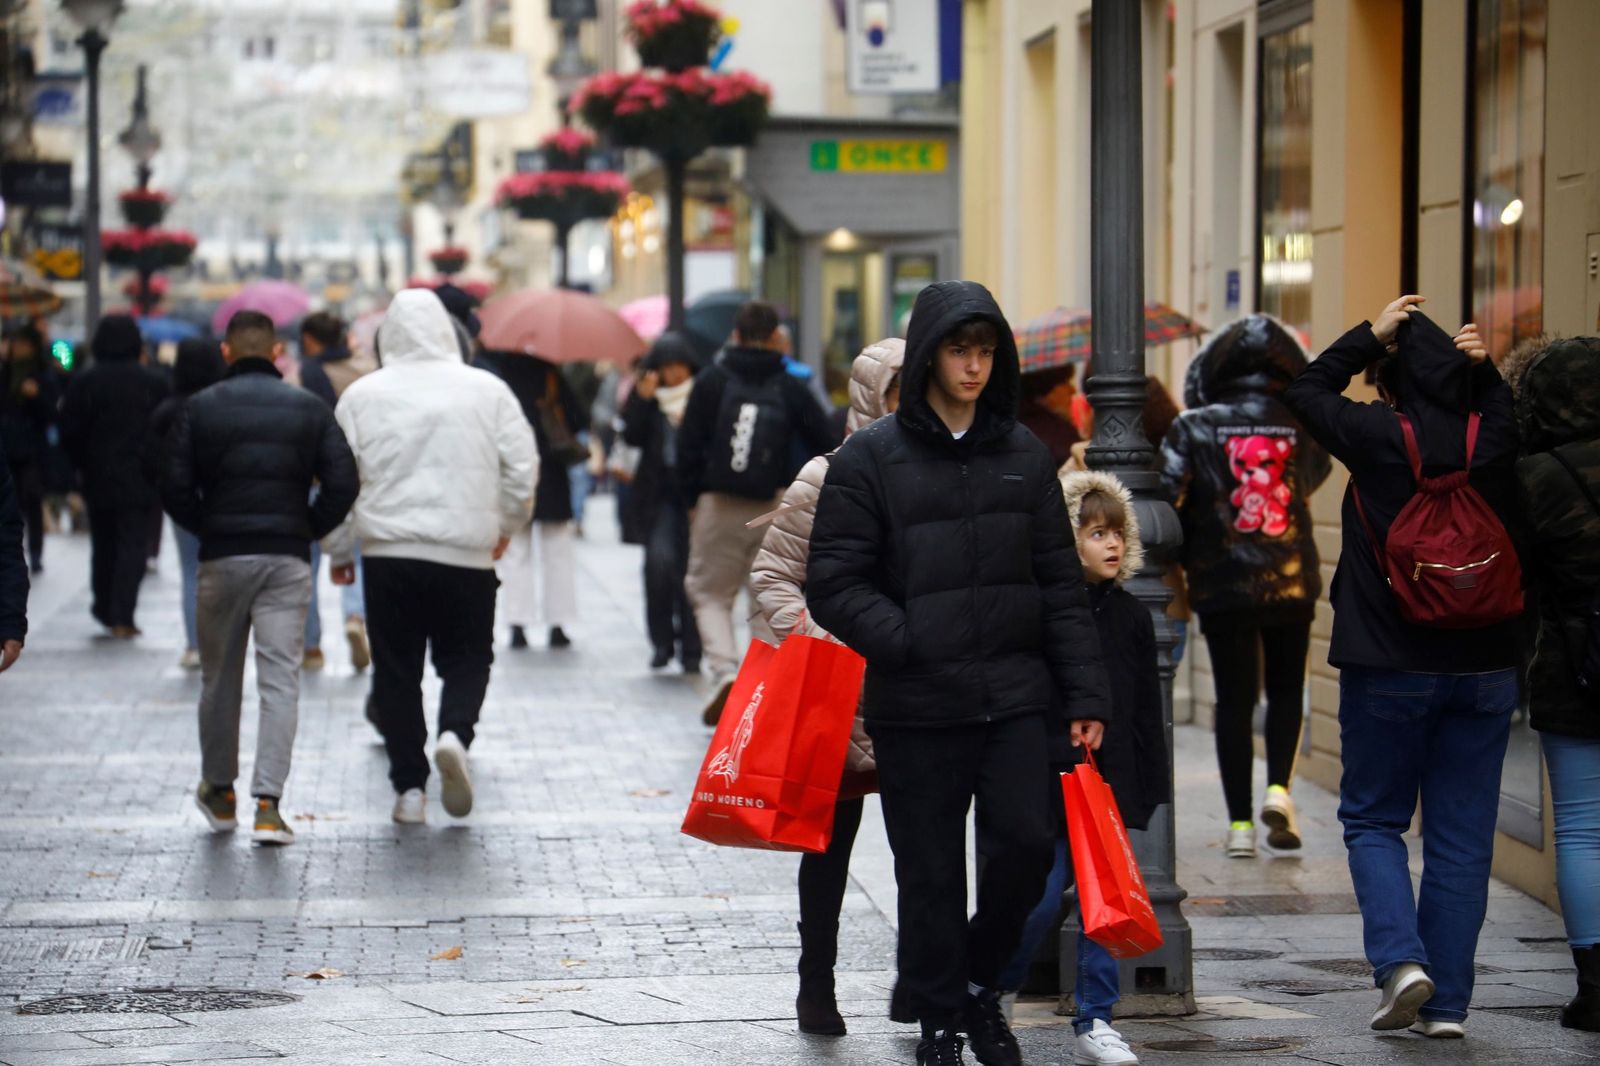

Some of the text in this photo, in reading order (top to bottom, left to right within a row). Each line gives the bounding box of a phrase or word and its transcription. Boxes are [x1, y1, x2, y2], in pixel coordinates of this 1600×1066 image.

[849, 143, 934, 166] ONCE
[1217, 426, 1297, 435] PRIVATE PROPERTY
[718, 795, 764, 809] MORENO
